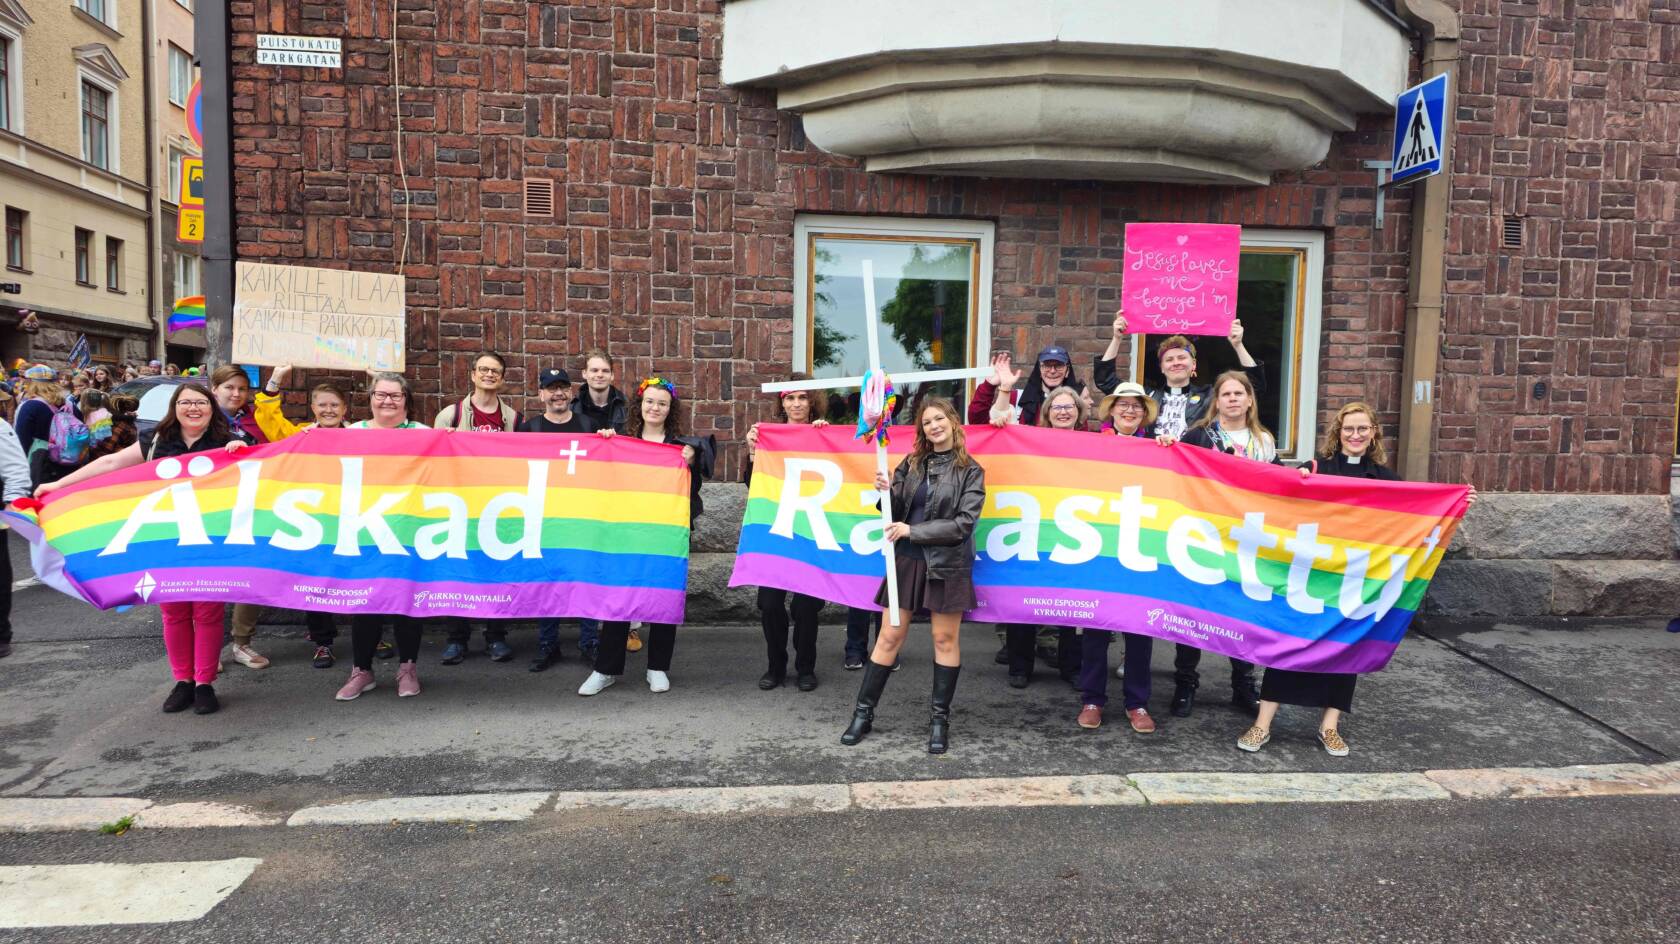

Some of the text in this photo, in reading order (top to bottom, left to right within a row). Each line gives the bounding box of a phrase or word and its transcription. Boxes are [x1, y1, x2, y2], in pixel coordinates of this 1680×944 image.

[260, 37, 338, 50] PUISTOKATU
[262, 52, 336, 65] PARKGATAN
[188, 223, 196, 236] 2
[1128, 246, 1232, 281] Jesus loves
[241, 264, 401, 305] KAIKILLE TILAA
[1152, 274, 1204, 292] me
[273, 291, 348, 315] RIITTÄÄ
[1133, 287, 1196, 315] because
[239, 308, 398, 340] KAIKILLE PAIKKOJA
[237, 332, 264, 357] ON
[97, 455, 550, 561] Älskad
[768, 457, 1411, 623] Raastettu
[293, 584, 368, 597] KIRKKO ESPOOSSA
[428, 592, 512, 603] KIRKKO VANTAALLA
[305, 595, 340, 606] KYRKAN
[347, 598, 368, 606] ESBO
[1023, 597, 1095, 609] KIRKKO ESPOOSSA
[1034, 608, 1067, 617] KYRKAN
[1073, 611, 1094, 620] ESBO
[1162, 623, 1185, 635] Kyrkan
[1190, 630, 1209, 642] Vanda
[1163, 613, 1244, 642] KIRKKO VANTAALLA
